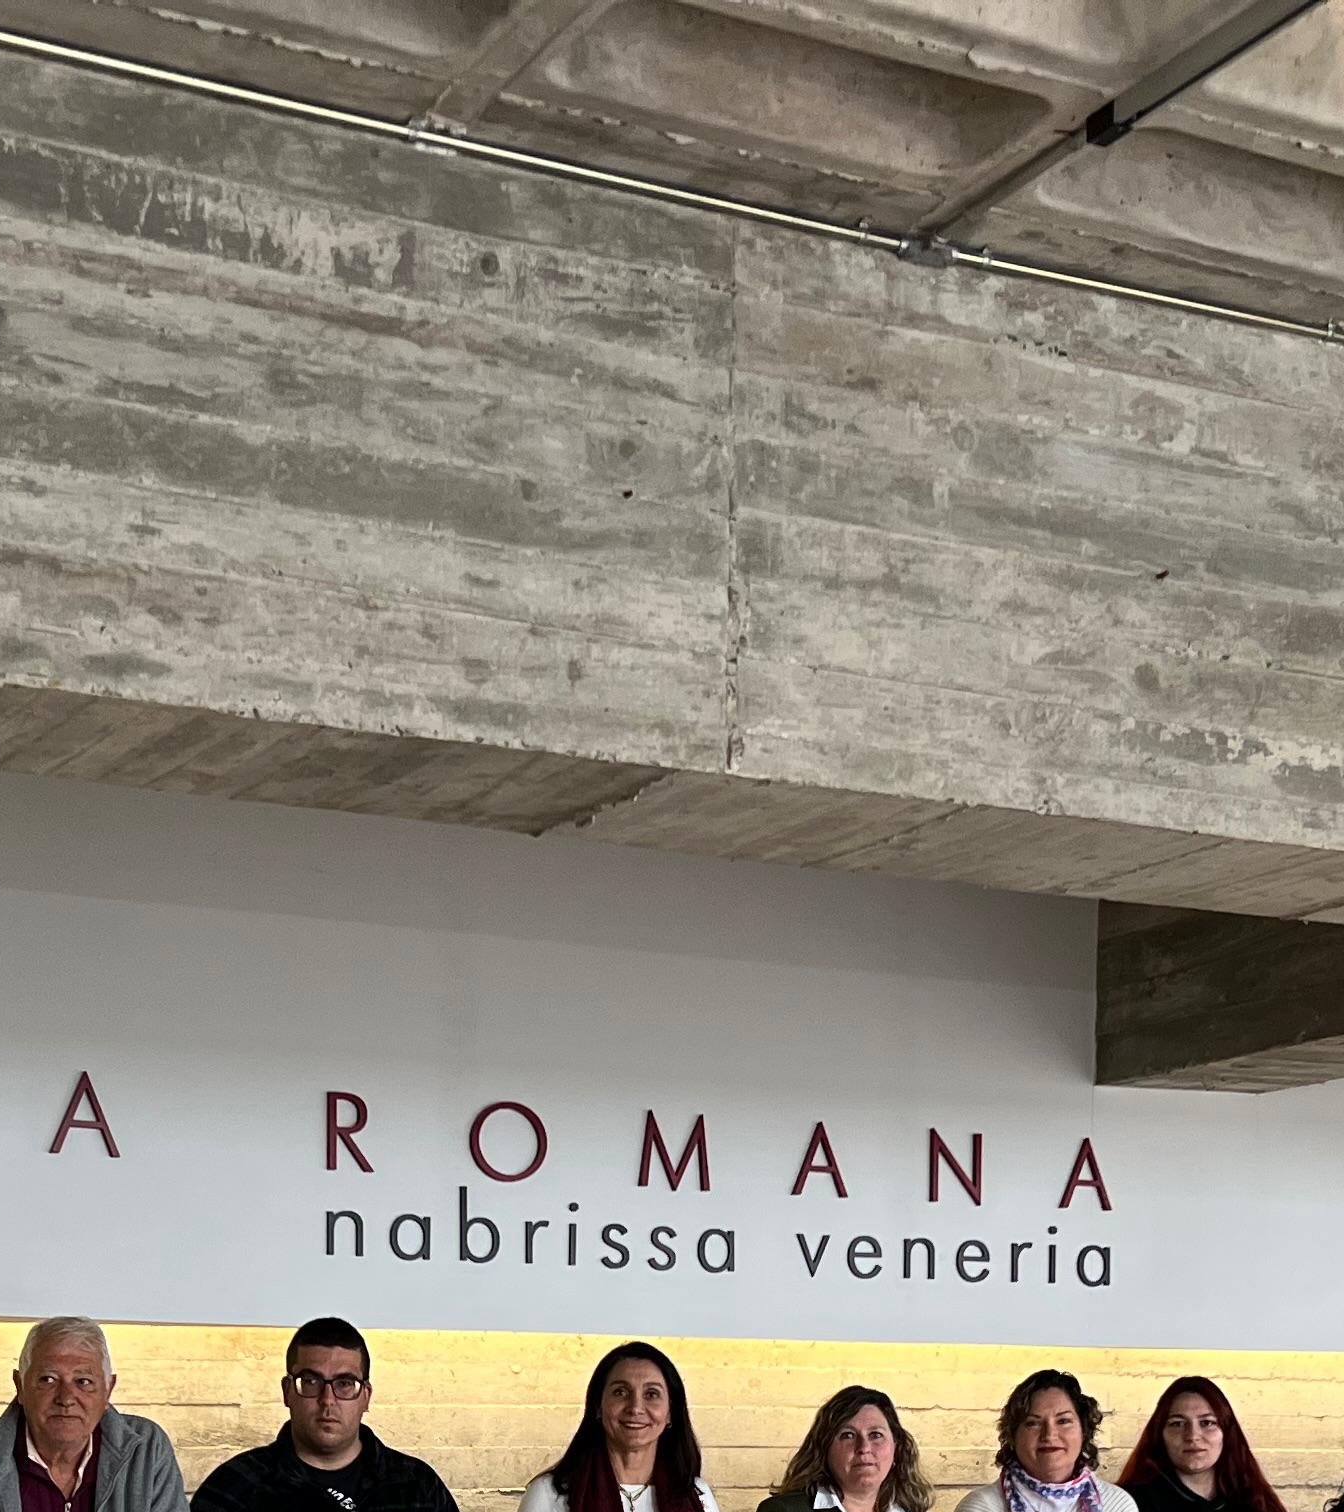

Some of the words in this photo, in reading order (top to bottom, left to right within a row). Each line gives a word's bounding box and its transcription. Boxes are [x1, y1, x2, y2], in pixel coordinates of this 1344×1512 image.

[325, 1091, 1112, 1211] ROMANA
[325, 1185, 736, 1274] nabrissa
[795, 1225, 1112, 1288] veneria
